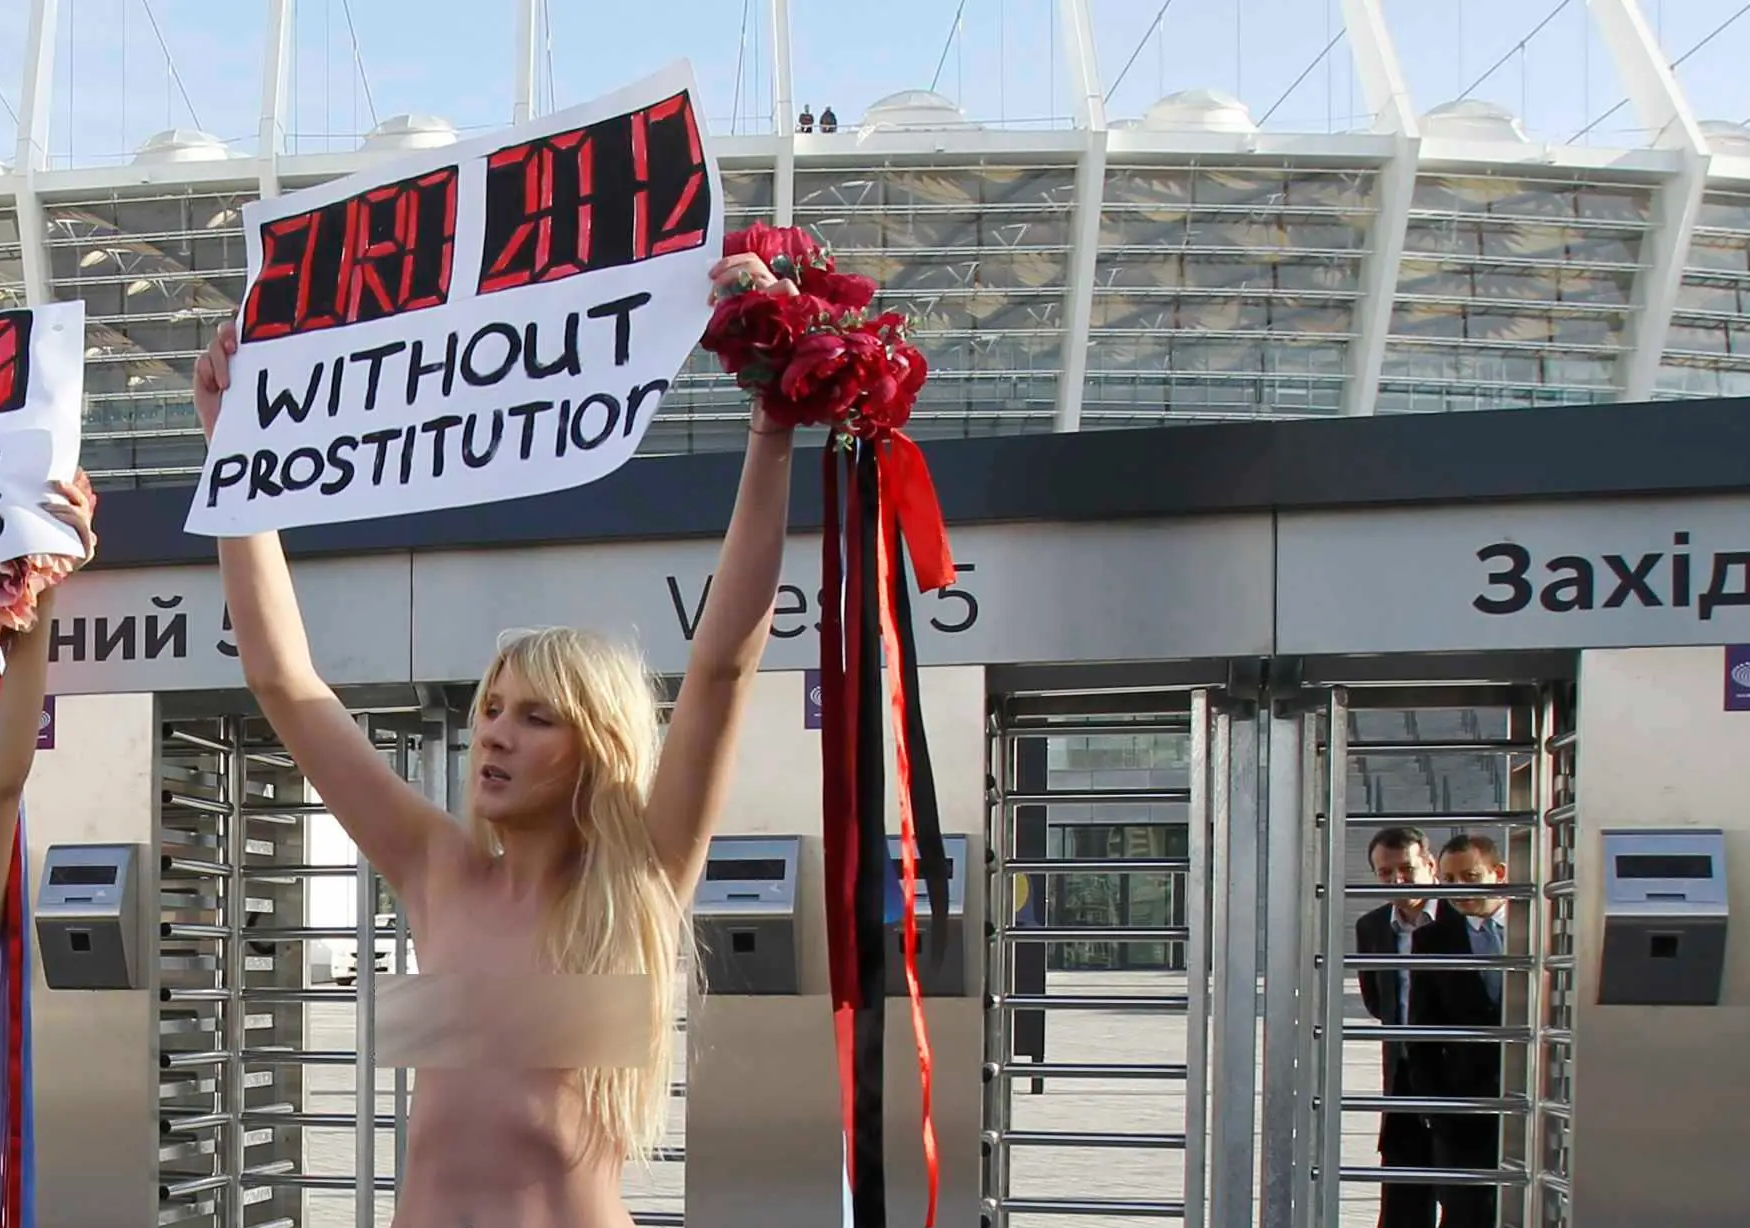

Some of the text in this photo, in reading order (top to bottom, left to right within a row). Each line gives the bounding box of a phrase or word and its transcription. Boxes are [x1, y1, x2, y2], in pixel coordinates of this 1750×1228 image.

[479, 93, 705, 294] 2012
[257, 292, 651, 429] WITHOUT
[929, 563, 979, 633] 5
[1472, 531, 1750, 621] Захід
